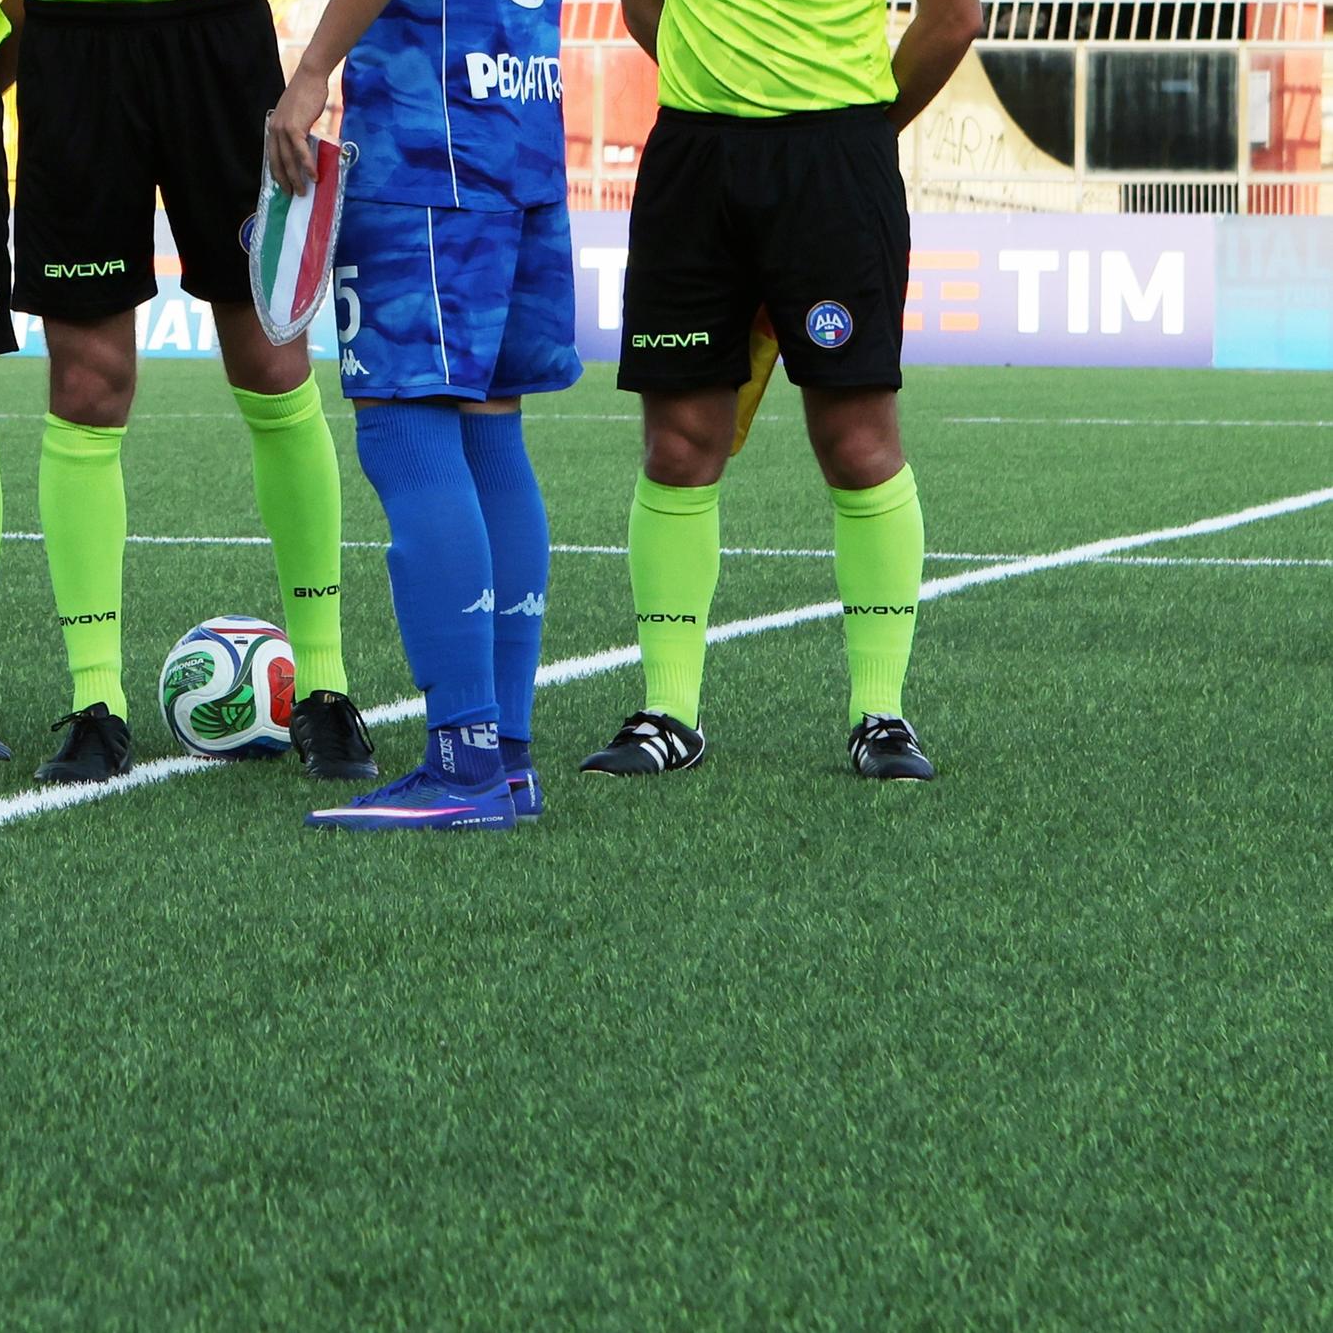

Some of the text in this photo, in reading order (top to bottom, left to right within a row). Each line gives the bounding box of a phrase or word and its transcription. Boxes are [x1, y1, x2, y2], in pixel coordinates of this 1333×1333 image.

[44, 259, 125, 278] GIVOVA
[998, 249, 1185, 335] TIM
[334, 265, 361, 344] 5
[632, 331, 709, 348] GIVOVA
[294, 584, 340, 598] GIVO
[843, 605, 914, 615] GIVOVA
